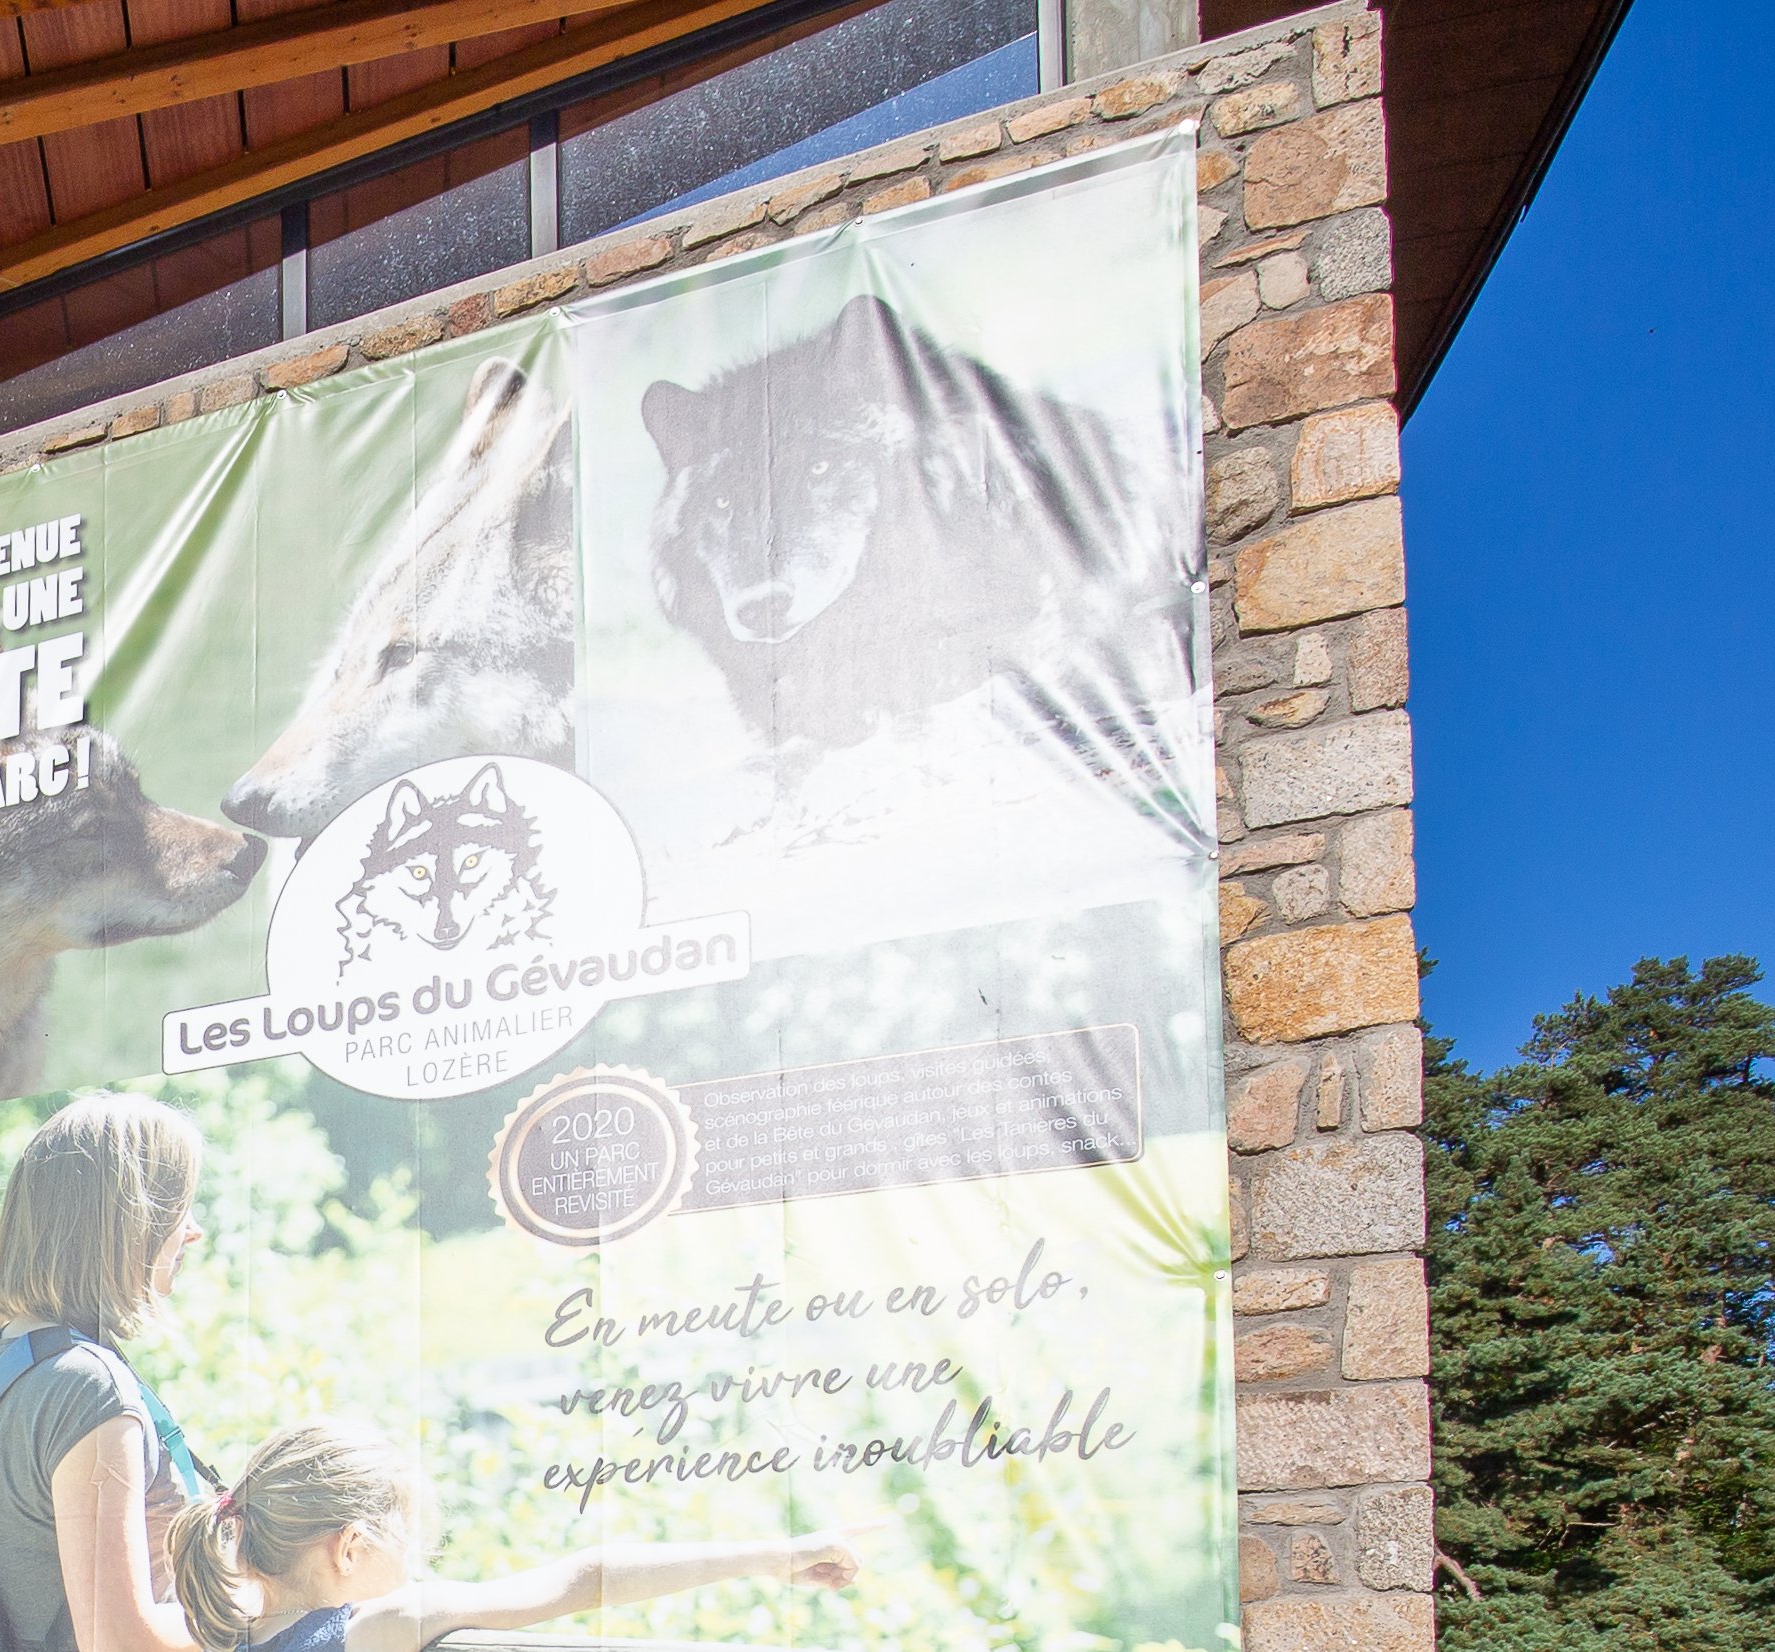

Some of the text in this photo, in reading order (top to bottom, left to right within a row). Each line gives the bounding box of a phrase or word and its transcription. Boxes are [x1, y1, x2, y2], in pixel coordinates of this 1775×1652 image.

[2, 566, 84, 632] UNE
[179, 933, 737, 1057] Les Loups du Gévaudan
[345, 1005, 574, 1064] PARC ANIMALIER
[406, 1049, 509, 1089] LOZÈRE
[704, 1082, 808, 1108] Observation
[813, 1078, 846, 1093] des
[911, 1063, 967, 1079] visites
[552, 1106, 635, 1145] 2020
[704, 1104, 822, 1130] scénographie
[903, 1083, 962, 1104] autour
[967, 1079, 1003, 1095] des
[1007, 1069, 1073, 1089] contes
[705, 1086, 1123, 1151] et de la Bête du Gévaudan, jeux et animations
[550, 1141, 641, 1171] UN PARC
[705, 1159, 746, 1176] pour
[750, 1151, 798, 1171] petits
[803, 1147, 819, 1161] et
[1083, 1110, 1108, 1127] du
[808, 1167, 848, 1185] pour
[854, 1158, 913, 1178] dormir
[917, 1153, 962, 1171] avec
[967, 1147, 993, 1163] les
[532, 1161, 659, 1196] ENTIÈREMENT
[555, 1183, 635, 1216] REVISITÉ
[544, 1236, 1089, 1348] En meute ou en solo,
[560, 1354, 965, 1445] venez vivre une
[543, 1386, 1137, 1515] expérience inoubliable
